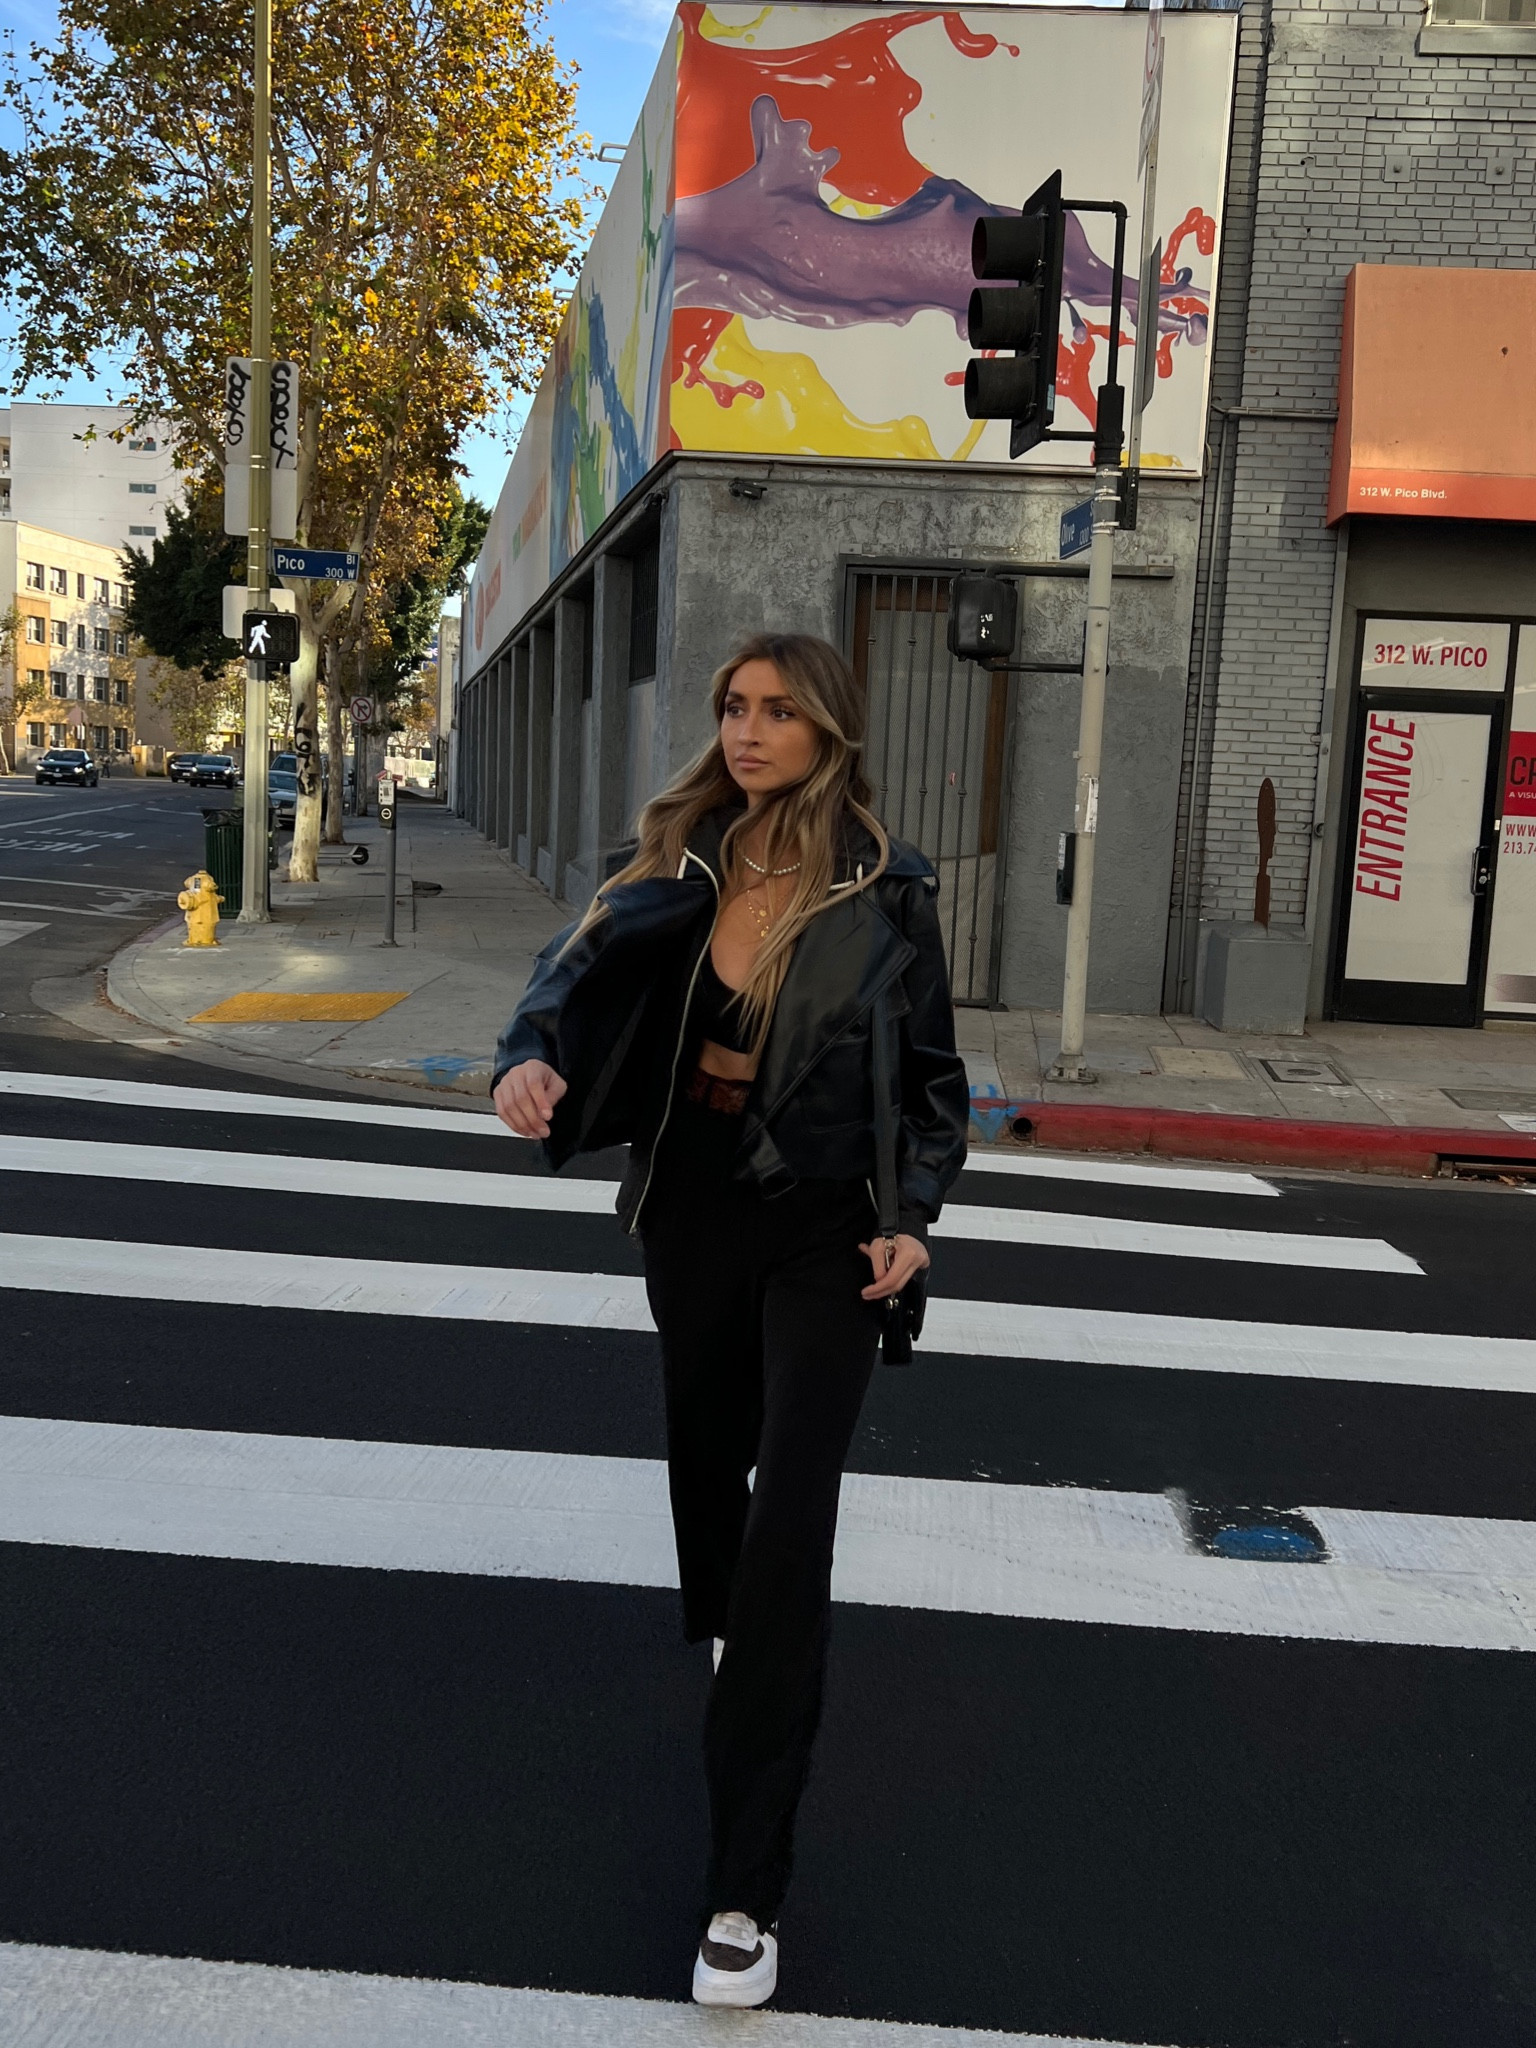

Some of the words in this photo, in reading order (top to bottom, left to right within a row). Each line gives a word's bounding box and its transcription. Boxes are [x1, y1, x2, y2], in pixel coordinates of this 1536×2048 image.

[1360, 486, 1378, 497] 312
[1380, 487, 1392, 497] W.
[1395, 488, 1418, 498] Pico
[1421, 488, 1447, 499] Blvd.
[325, 567, 344, 578] 300
[347, 568, 355, 579] W
[1374, 643, 1406, 665] 312
[1412, 644, 1434, 666] W.
[1440, 646, 1488, 668] PICO
[1355, 713, 1415, 901] ENTRANCE
